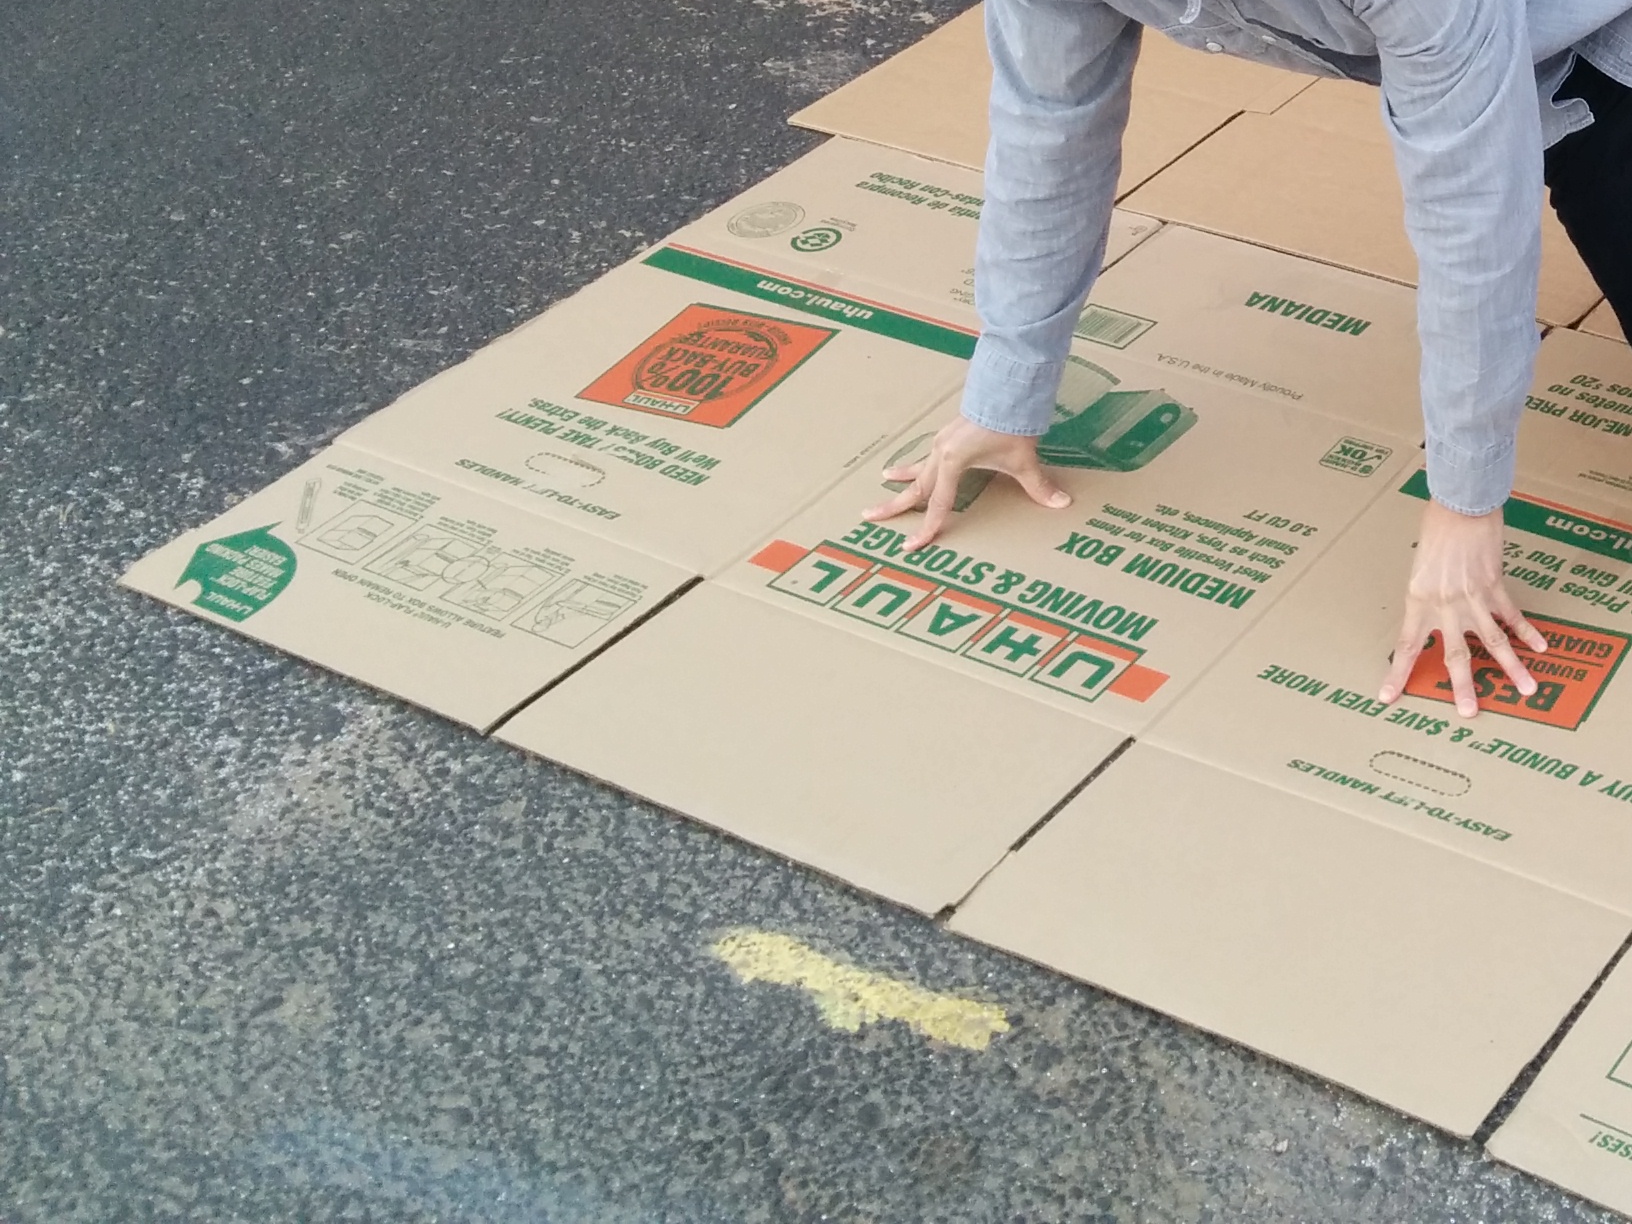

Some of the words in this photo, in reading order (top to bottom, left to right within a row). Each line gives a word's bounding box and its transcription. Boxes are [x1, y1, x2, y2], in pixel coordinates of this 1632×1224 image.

[865, 170, 923, 191] Recibo
[851, 178, 931, 206] Recompra
[922, 199, 950, 211] de
[750, 278, 876, 321] uhaul.com
[1238, 289, 1373, 337] MEDIANA
[657, 345, 761, 377] BUY-BACK
[1151, 351, 1193, 368] U.S.A.
[1189, 362, 1212, 373] the
[636, 360, 732, 400] 100%
[1208, 368, 1225, 377] in
[1220, 371, 1259, 387] Made
[1567, 372, 1607, 391] $20
[1255, 381, 1305, 400] Proudly
[1545, 382, 1576, 397] no
[520, 396, 583, 422] Extras.
[493, 406, 565, 436] PLENTY!
[572, 414, 609, 432] the
[554, 427, 604, 449] TAKE
[599, 423, 650, 446] Back
[641, 435, 685, 456] Buy
[1331, 443, 1369, 460] OK
[672, 448, 723, 471] We'll
[452, 457, 527, 487] HANDLES
[656, 462, 711, 487] NEED
[1095, 502, 1145, 524] Items,
[1149, 502, 1182, 518] etc.
[1241, 507, 1270, 522] FT
[1081, 516, 1126, 536] Items
[1137, 516, 1195, 541] Kitchen
[1176, 509, 1261, 544] Appliances,
[1264, 514, 1292, 529] CU
[1286, 521, 1319, 538] 3.0
[1120, 529, 1148, 543] for
[1142, 536, 1175, 552] Box
[1189, 531, 1232, 552] Toys,
[1254, 535, 1300, 556] Small
[837, 519, 1000, 587] STORAGE
[1050, 530, 1127, 567] BOX
[1170, 544, 1236, 572] Versatile
[1227, 544, 1249, 556] as
[1244, 550, 1286, 570] Such
[1520, 548, 1568, 573] You
[329, 567, 361, 582] OPEN
[981, 568, 1030, 597] &
[1118, 551, 1258, 610] MEDIUM
[1230, 564, 1272, 584] Most
[1564, 562, 1620, 589] Give
[354, 577, 396, 596] REMAIN
[389, 590, 409, 601] TO
[403, 596, 429, 608] BOX
[1554, 580, 1632, 615] Prices
[423, 603, 466, 623] ALLOWS
[1012, 577, 1160, 641] MOVING
[460, 617, 508, 639] FEATURE
[1254, 662, 1331, 698] MORE
[1323, 685, 1392, 719] EVEN
[1382, 703, 1452, 739] $AVE
[1444, 724, 1475, 745] &
[1285, 756, 1381, 797] HANDLES
[1576, 768, 1605, 789] A
